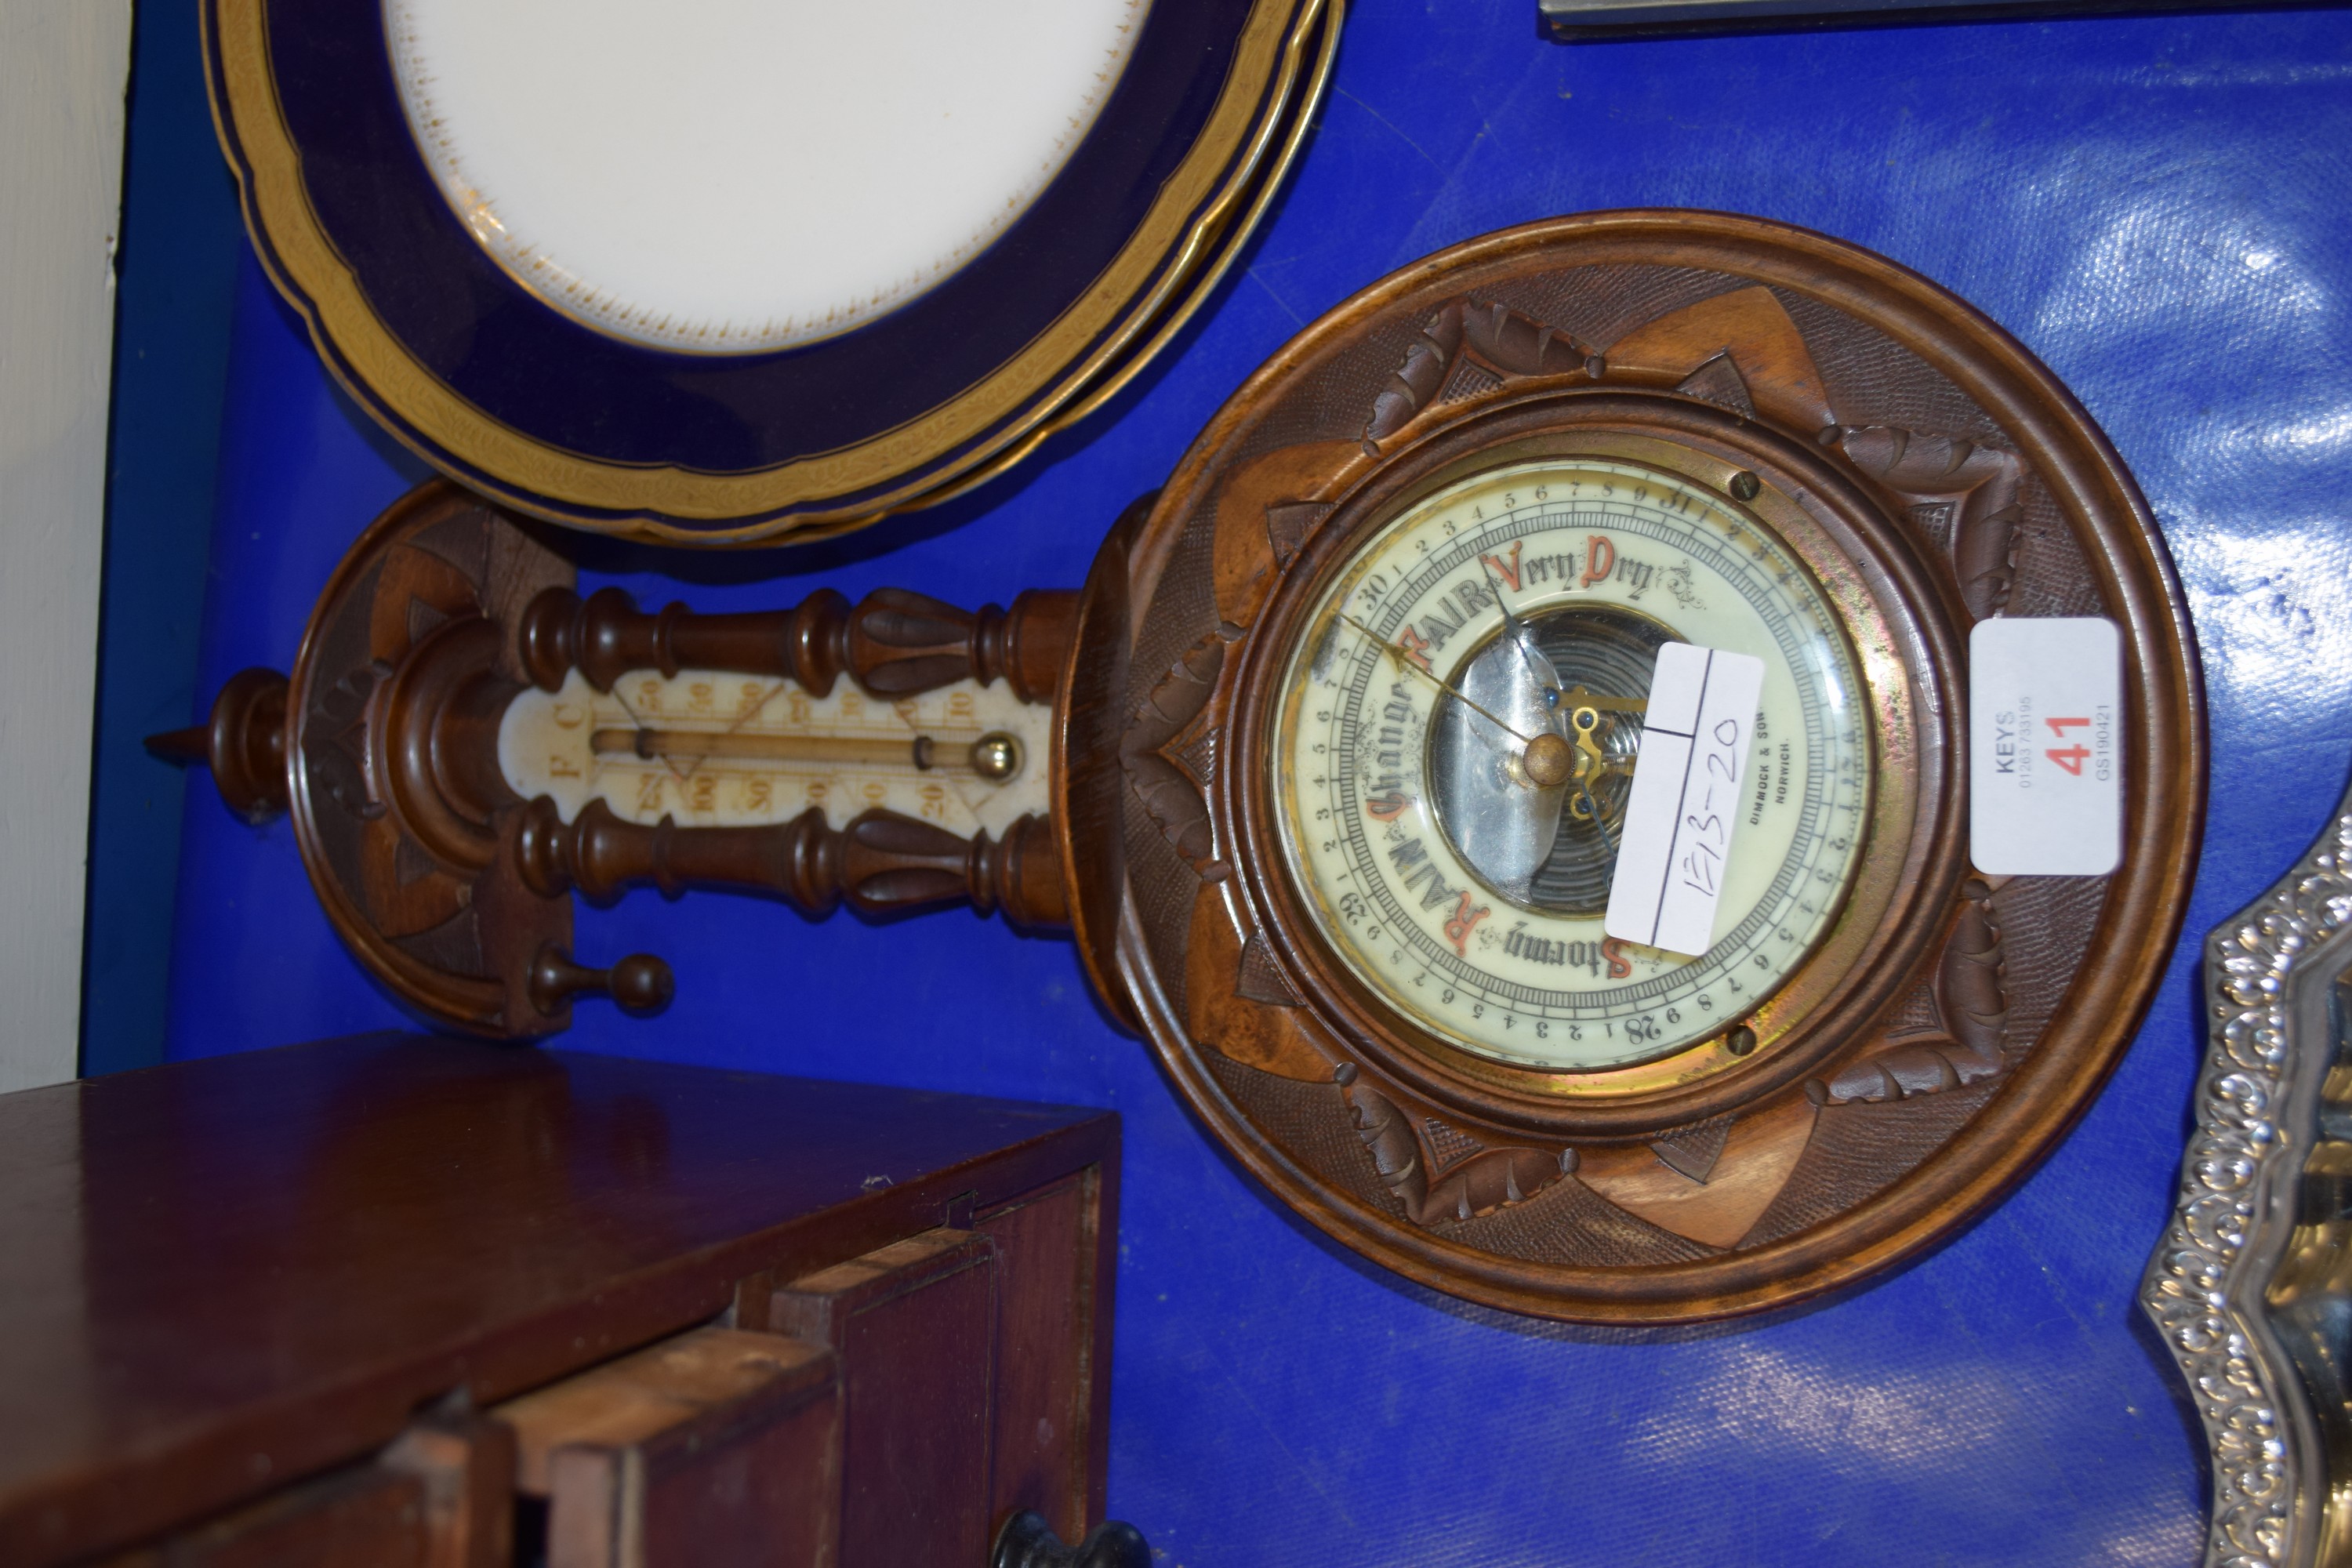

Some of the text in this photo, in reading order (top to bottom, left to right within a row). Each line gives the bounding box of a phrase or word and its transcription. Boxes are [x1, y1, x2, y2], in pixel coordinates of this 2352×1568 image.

[1535, 485, 1548, 500] 6
[1570, 480, 1581, 496] 7
[1601, 481, 1613, 497] 8
[1634, 486, 1647, 501] 9
[1504, 493, 1515, 508] 5
[1659, 485, 1691, 514] 31
[1472, 505, 1485, 520] 4
[1443, 521, 1456, 536] 3
[1416, 539, 1429, 554] 2
[1392, 564, 1403, 576] 1
[1479, 535, 1654, 601] Very Dry
[1358, 574, 1388, 611] 30
[1396, 579, 1491, 675] FAIR
[1324, 678, 1338, 689] 7
[840, 691, 862, 717] 10
[949, 691, 972, 717] 10
[553, 703, 583, 730] C
[1317, 710, 1330, 722] 6
[1312, 744, 1326, 755] 5
[1995, 710, 2015, 774] KEYS
[2045, 717, 2092, 776] 41
[2096, 705, 2111, 782] GS190421
[1366, 682, 1417, 822] Change
[551, 755, 580, 778] F
[1775, 738, 1791, 804] NORWICH.
[2019, 748, 2032, 788] 01263
[1312, 776, 1326, 789] 4
[1750, 765, 1770, 826] DIMMOCK
[1760, 747, 1771, 756] &
[692, 776, 714, 811] 100
[920, 786, 943, 818] 20
[1316, 808, 1330, 820] 3
[1323, 839, 1338, 853] 2
[1829, 837, 1846, 851] 2
[1336, 873, 1348, 881] 1
[1817, 868, 1832, 884] 3
[1388, 837, 1490, 958] RAIN
[1338, 892, 1368, 927] 29
[1798, 898, 1813, 914] 4
[1367, 925, 1381, 941] 9
[1778, 927, 1795, 943] 5
[1389, 949, 1403, 965] 8
[1502, 920, 1632, 979] Stormy
[1753, 954, 1769, 971] 6
[1727, 978, 1743, 994] 7
[1442, 989, 1455, 1004] 6
[1697, 993, 1712, 1011] 8
[1472, 1004, 1484, 1020] 5
[1666, 1007, 1681, 1024] 9
[1503, 1015, 1517, 1030] 4
[1536, 1022, 1548, 1039] 3
[1603, 1022, 1613, 1038] 1
[1624, 1014, 1661, 1045] 28
[1569, 1024, 1582, 1041] 2
